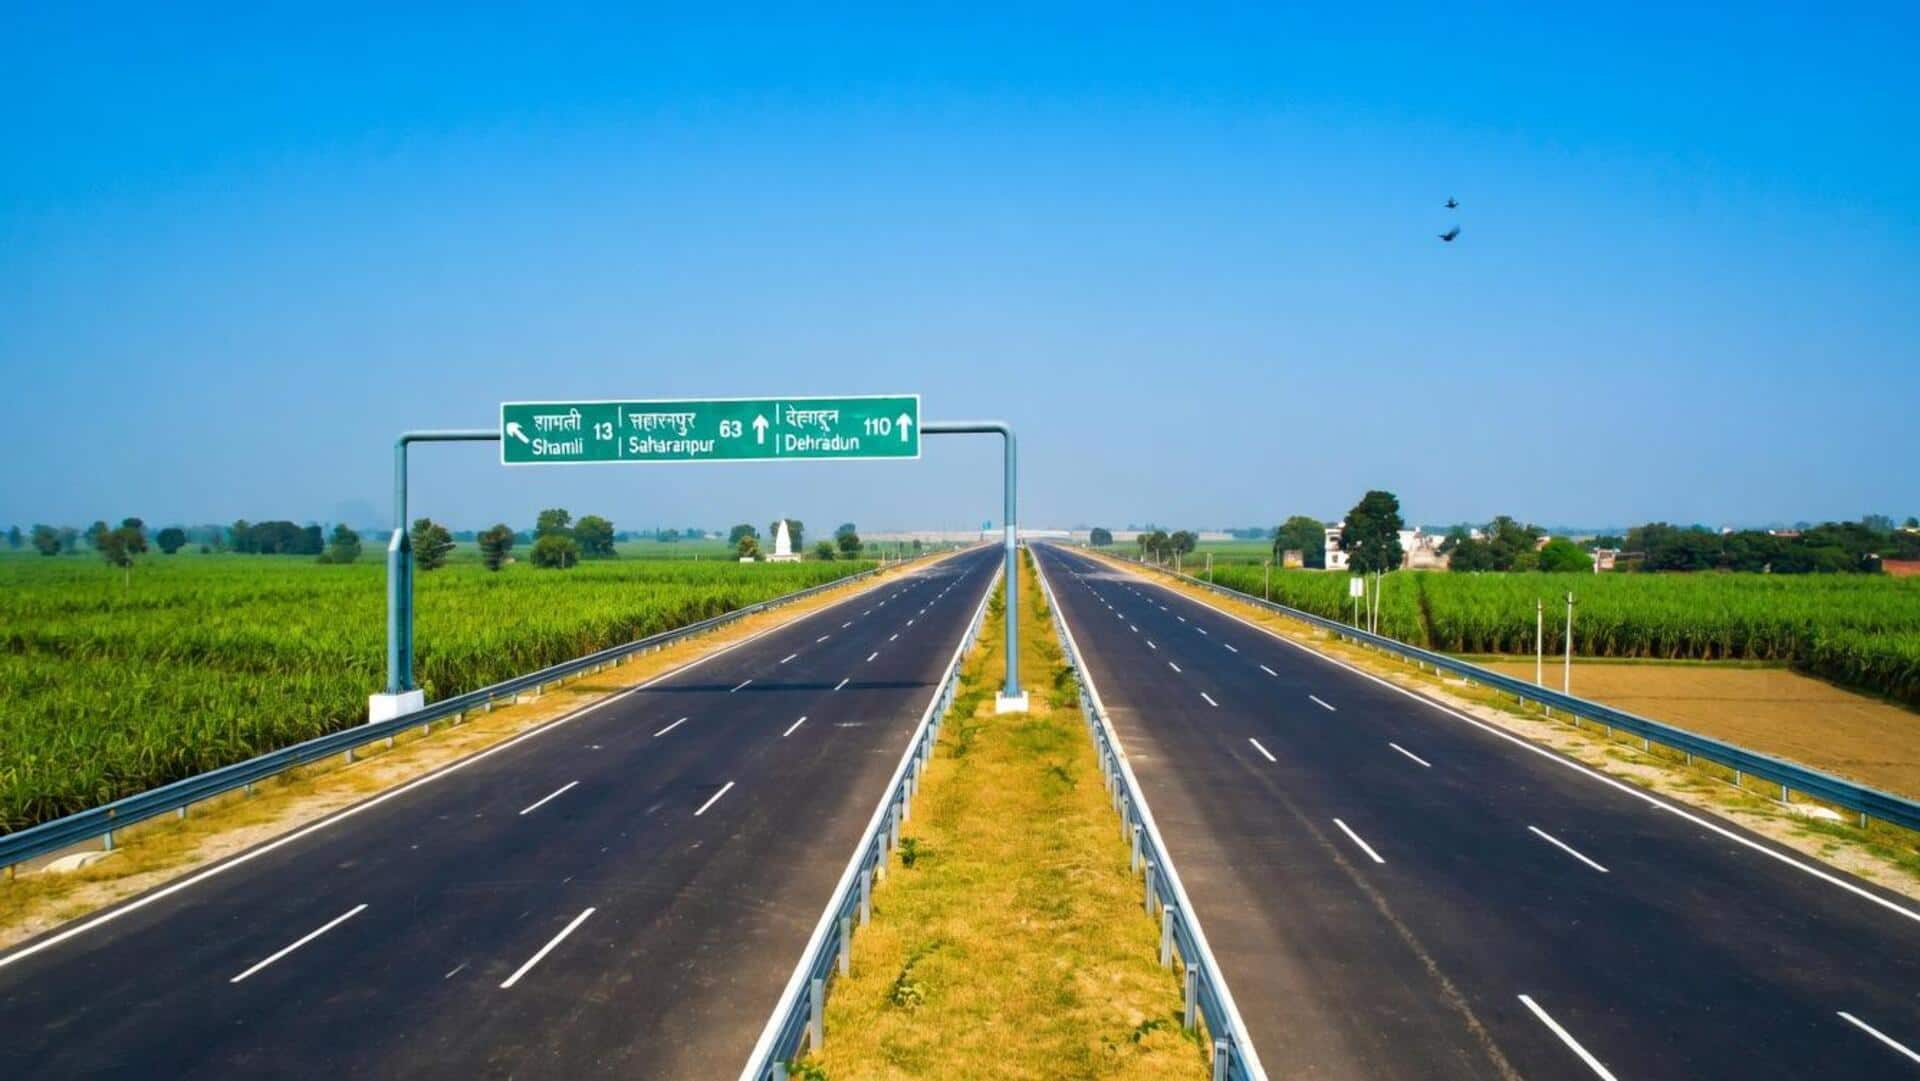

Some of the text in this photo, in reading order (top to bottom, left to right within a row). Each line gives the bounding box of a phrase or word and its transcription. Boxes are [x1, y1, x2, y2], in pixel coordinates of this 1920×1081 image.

[593, 422, 613, 440] 13
[719, 420, 743, 438] 63
[863, 417, 892, 436] 110
[532, 437, 583, 456] Shamli
[628, 436, 715, 456] Saharanpur
[785, 433, 860, 451] Dehradun
